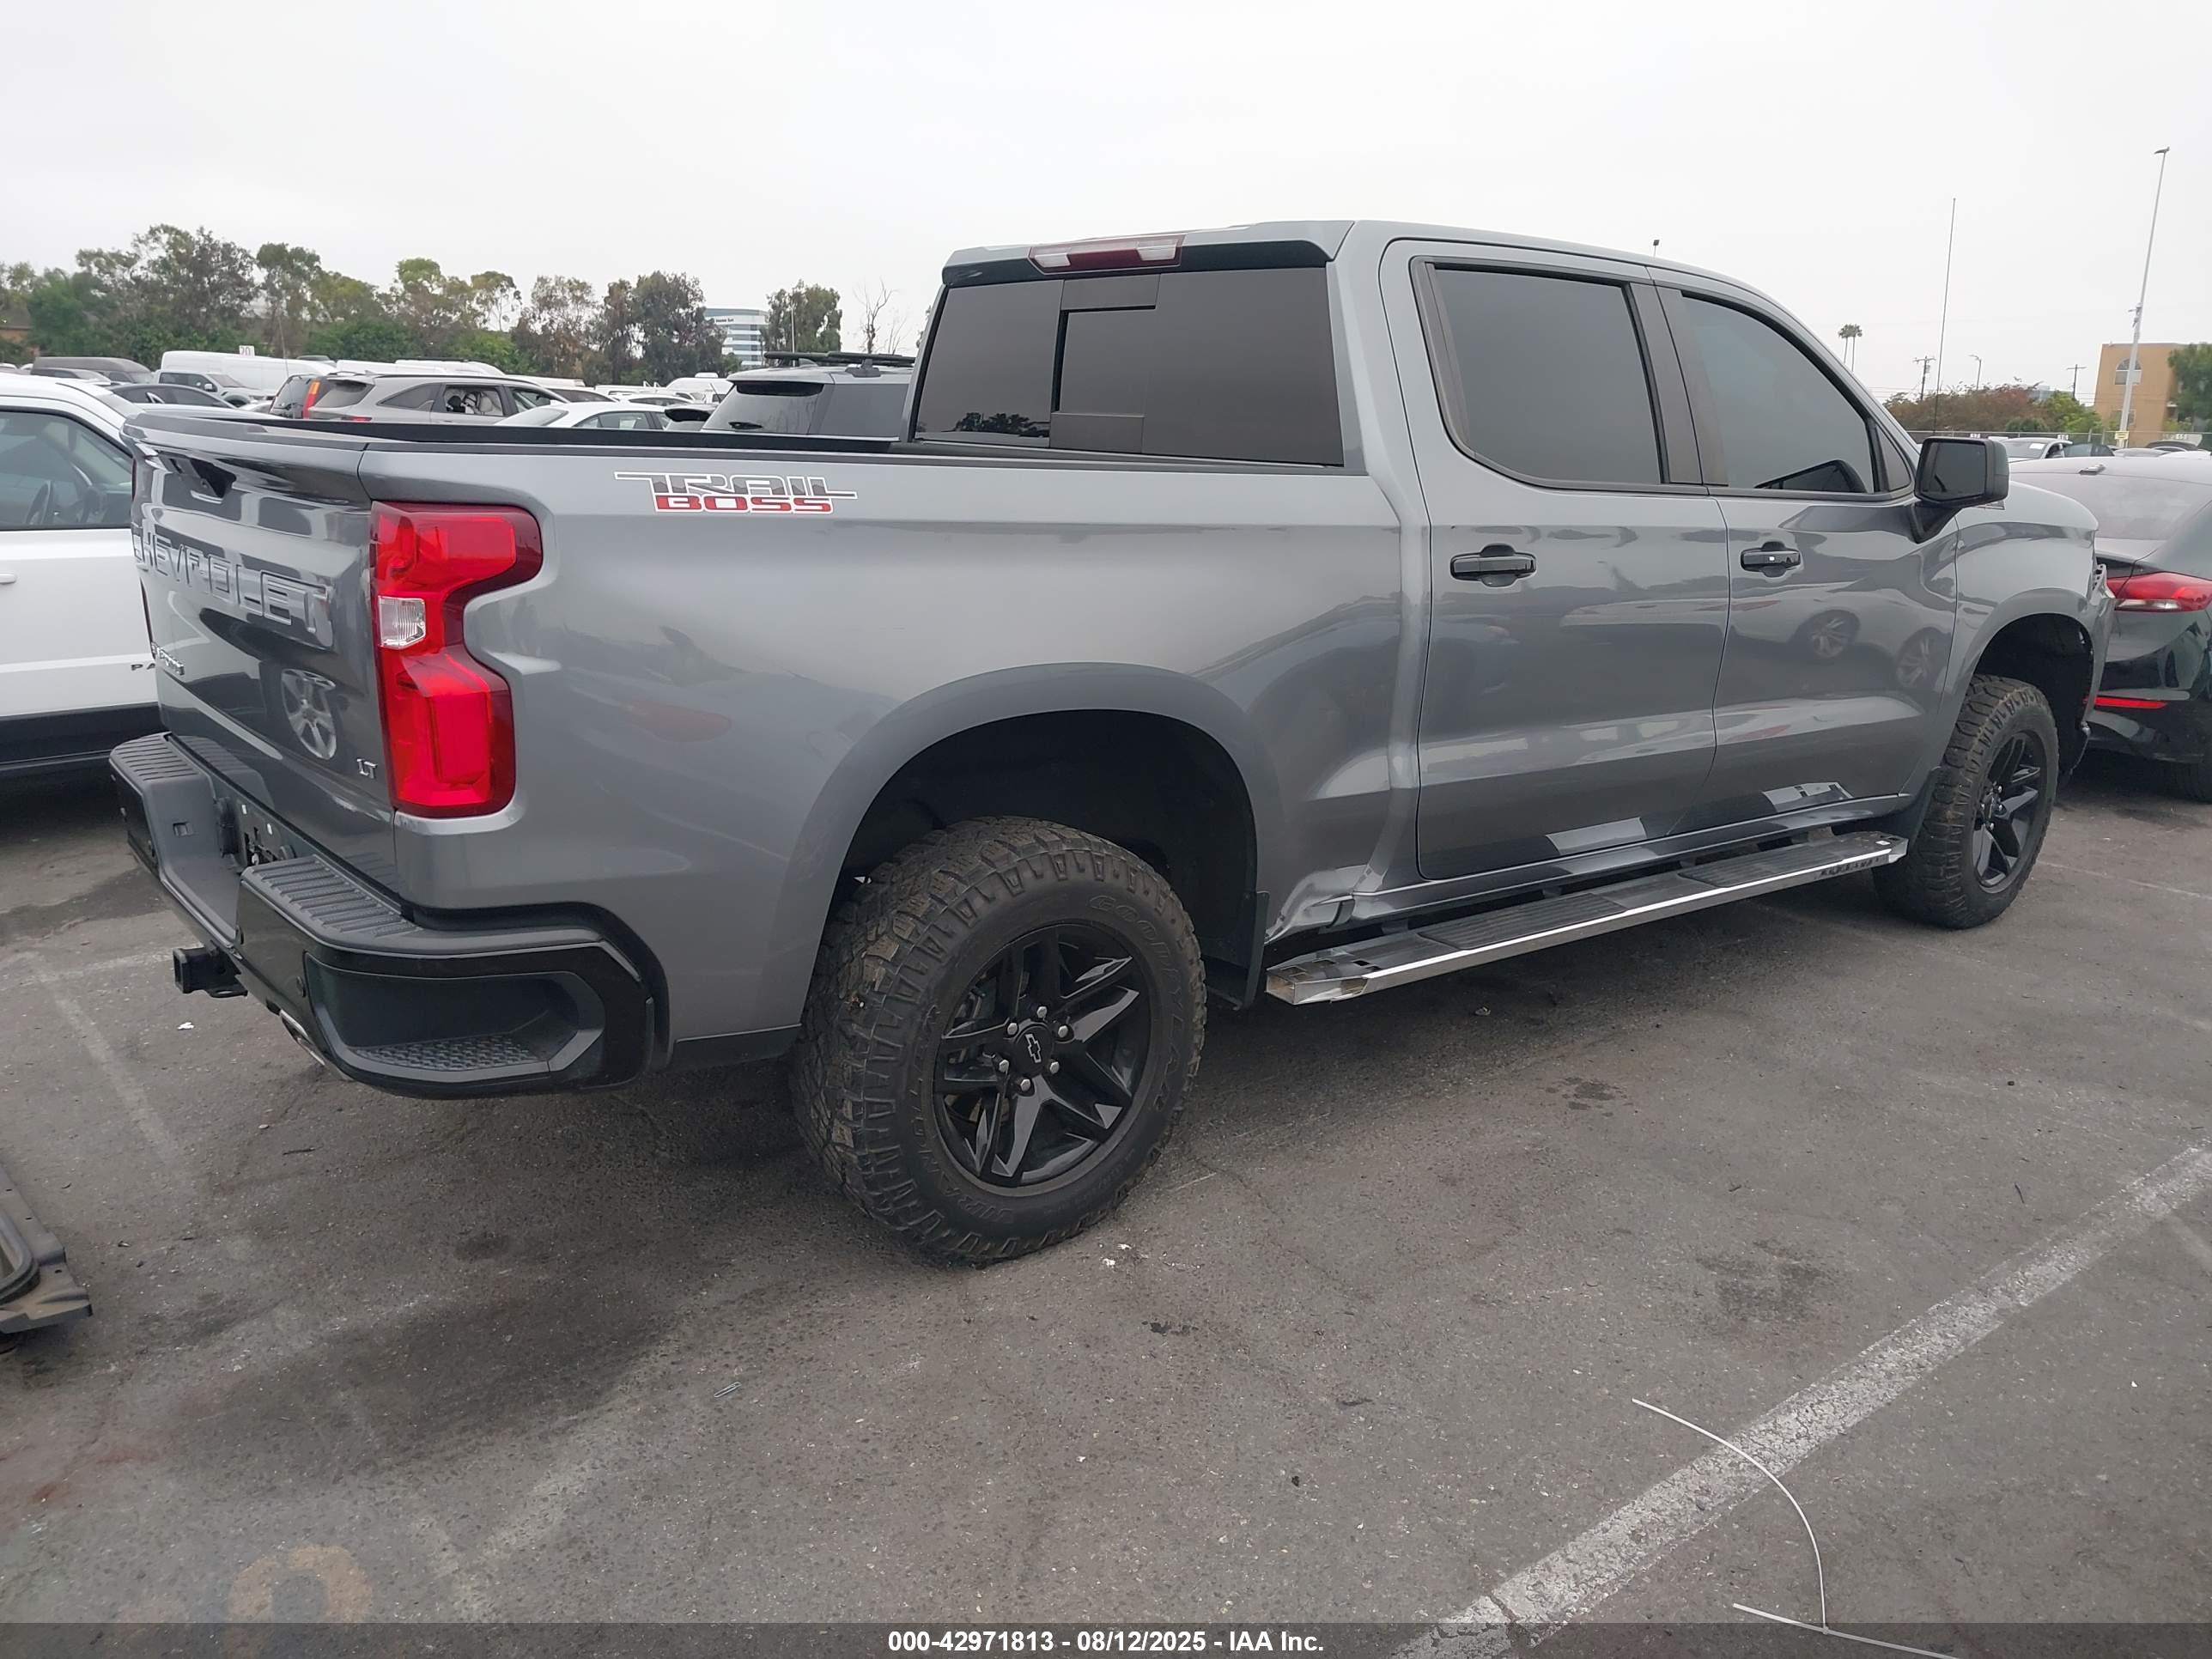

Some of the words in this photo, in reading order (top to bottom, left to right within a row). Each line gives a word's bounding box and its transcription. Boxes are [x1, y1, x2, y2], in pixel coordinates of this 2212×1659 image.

[614, 471, 857, 500] TRAIL
[654, 495, 833, 514] BOSS
[356, 758, 378, 779] LT
[1088, 895, 1184, 1111] GOODYEAR
